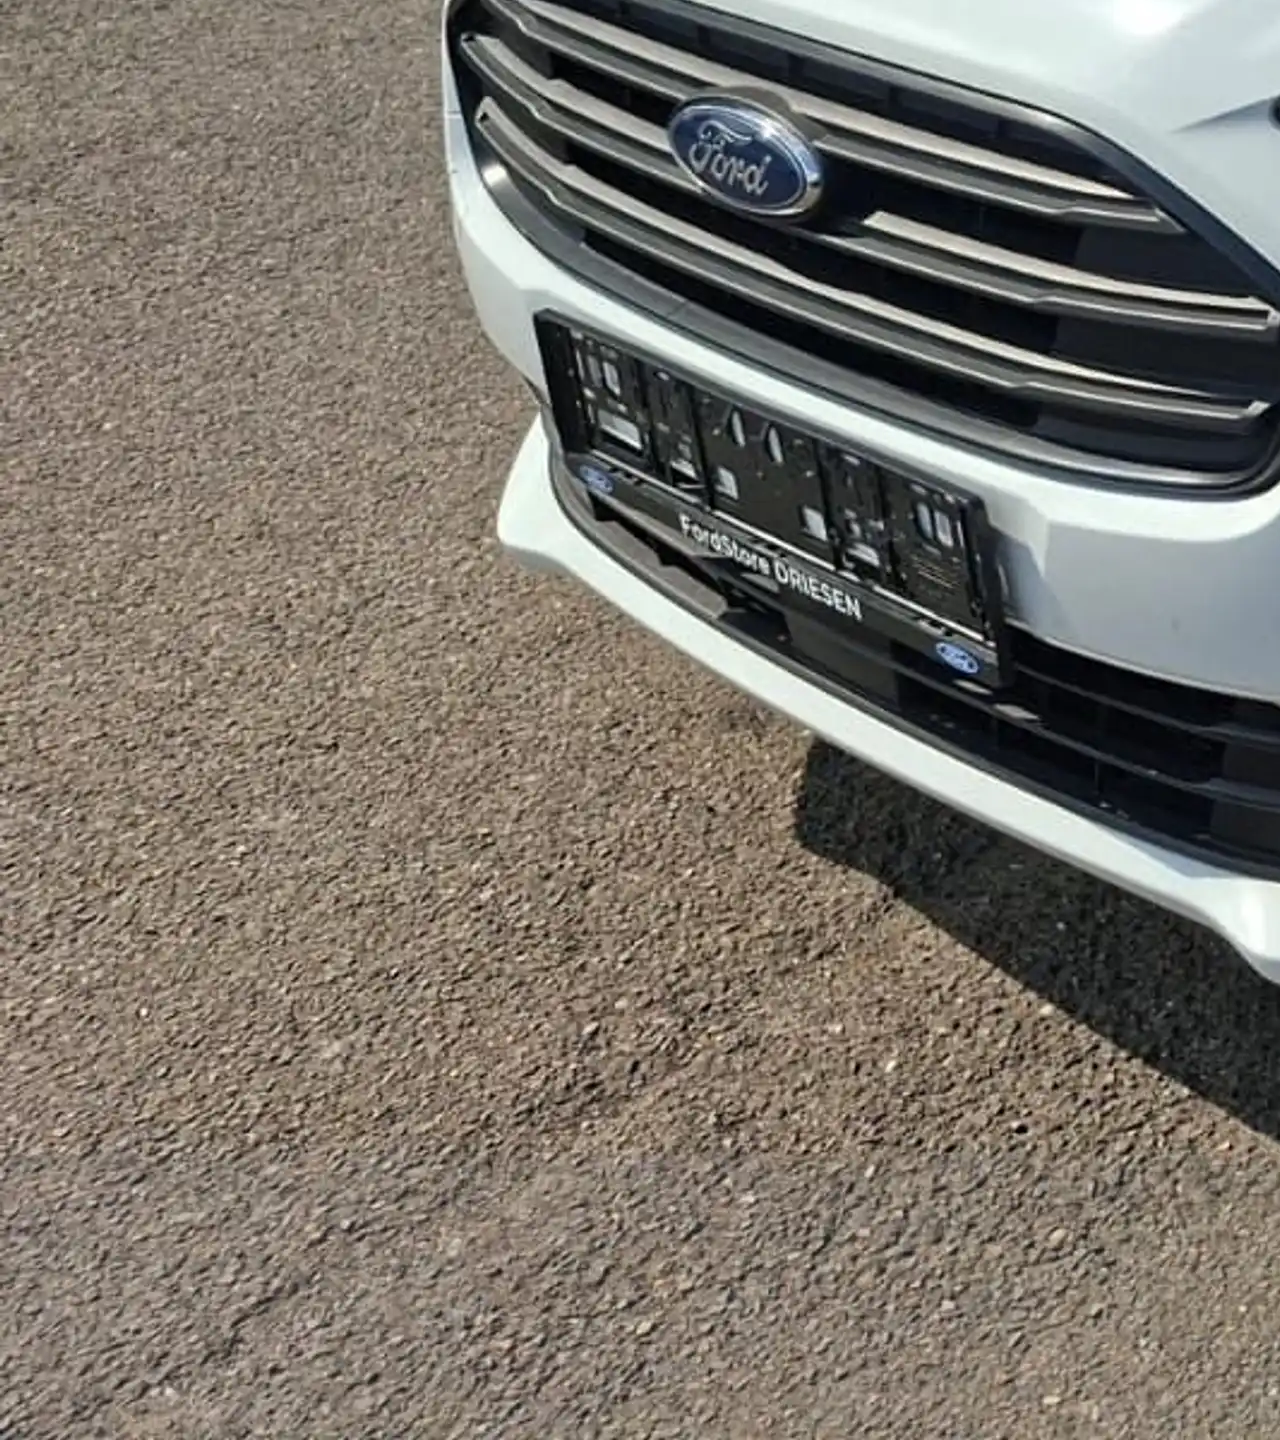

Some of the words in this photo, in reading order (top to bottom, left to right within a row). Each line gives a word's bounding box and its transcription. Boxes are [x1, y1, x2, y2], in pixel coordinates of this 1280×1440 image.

[688, 120, 773, 196] Ford
[679, 512, 770, 576] FordStore
[773, 559, 863, 622] DRIESEN
